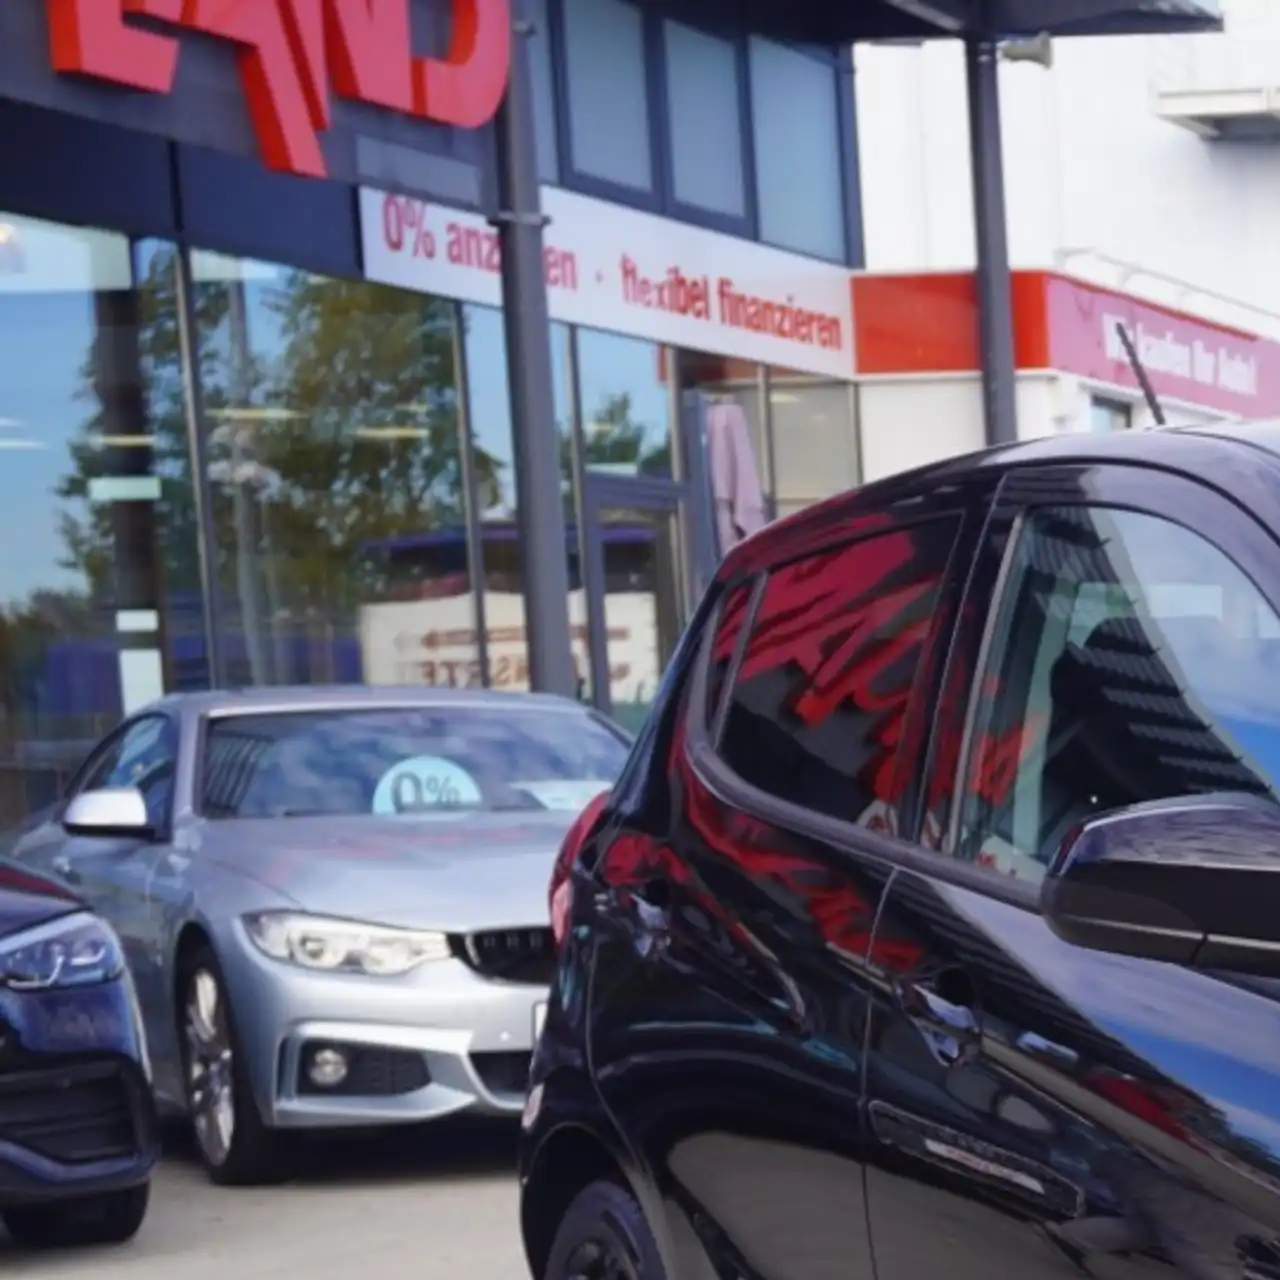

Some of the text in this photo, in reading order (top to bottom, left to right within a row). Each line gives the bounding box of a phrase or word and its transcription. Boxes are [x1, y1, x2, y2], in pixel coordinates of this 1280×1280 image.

[382, 187, 436, 260] 0%
[620, 252, 709, 320] flexibel
[718, 276, 842, 350] finanzieren
